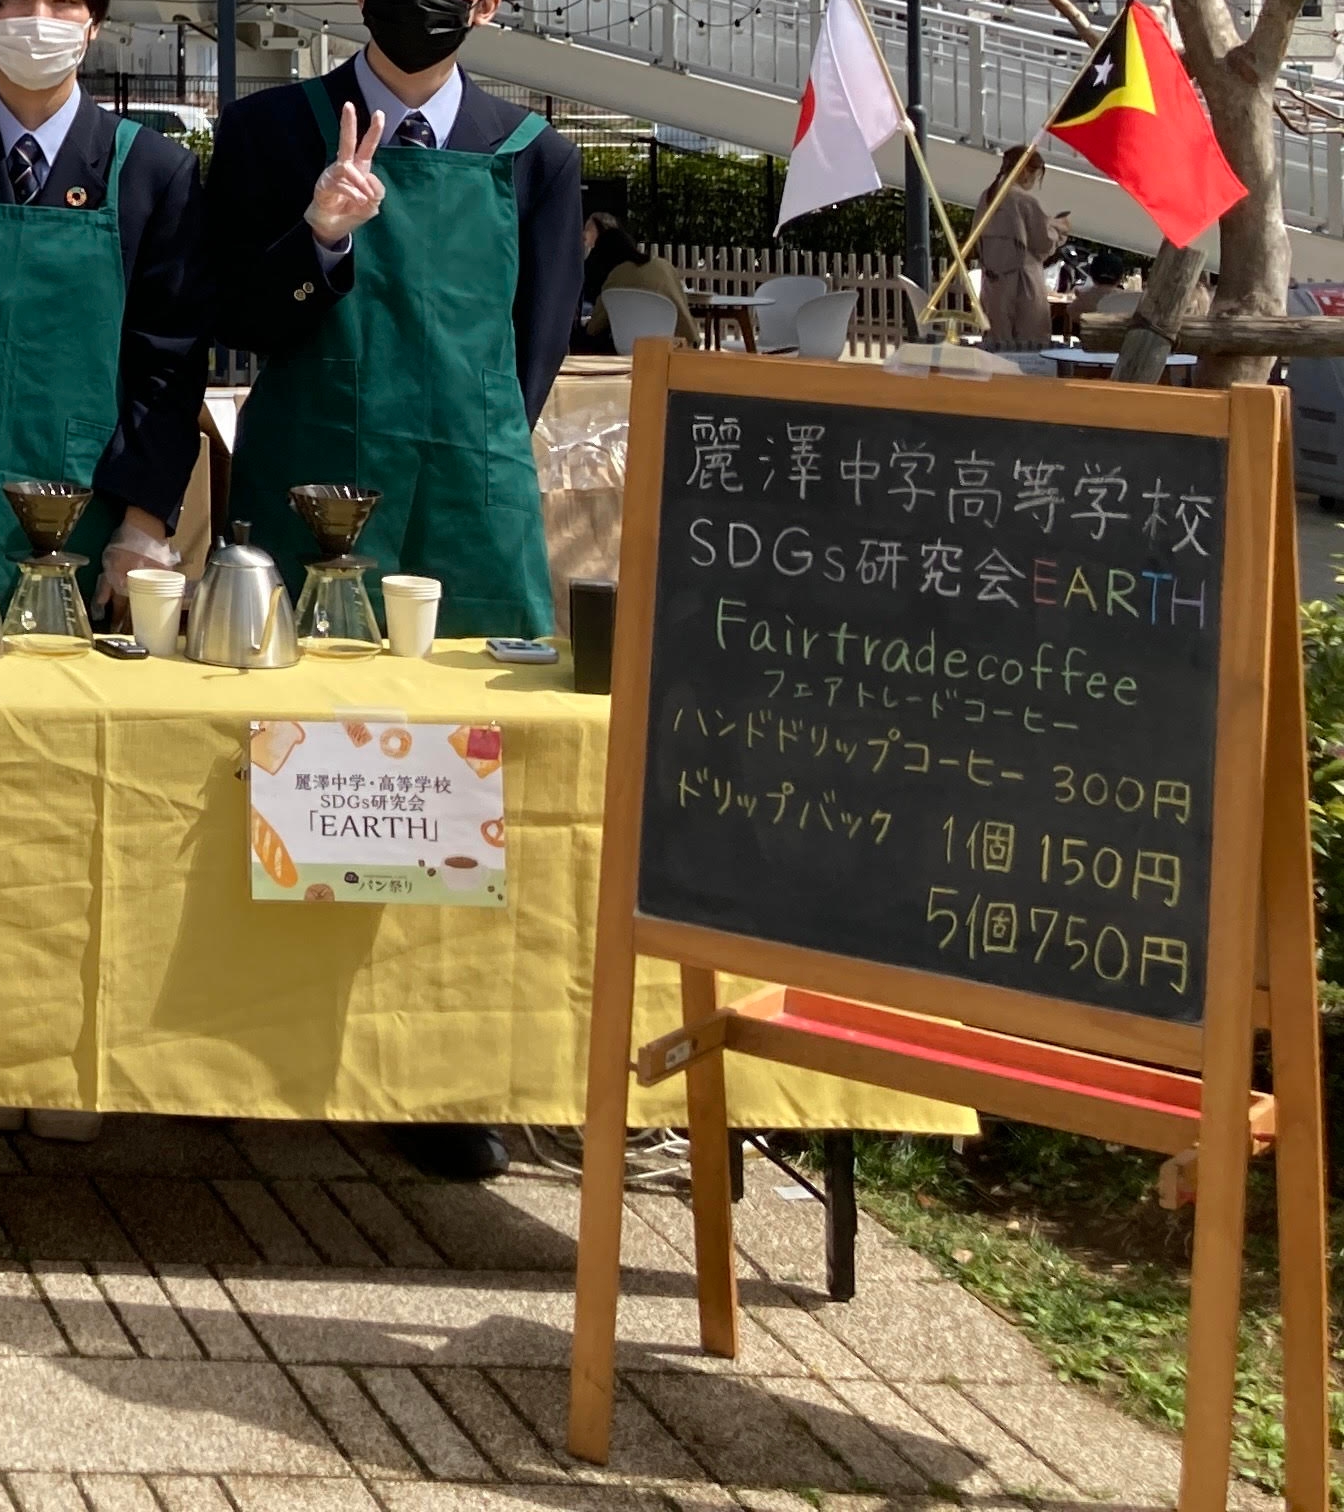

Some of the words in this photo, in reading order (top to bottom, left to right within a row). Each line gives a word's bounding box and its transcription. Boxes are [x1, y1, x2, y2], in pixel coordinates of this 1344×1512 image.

[686, 414, 1215, 557] 麗澤中学高等学校
[764, 669, 1080, 732] フェアトレードコーヒー
[295, 773, 452, 794] 麗澤中学・高等学校
[672, 706, 1025, 783] ハンドドリップコーヒー
[1052, 763, 1193, 825] 300円
[309, 810, 439, 842] 「EARTH」
[319, 794, 426, 813] SDGs研究会
[678, 769, 893, 844] ドリップバック
[1039, 832, 1184, 908] 150円
